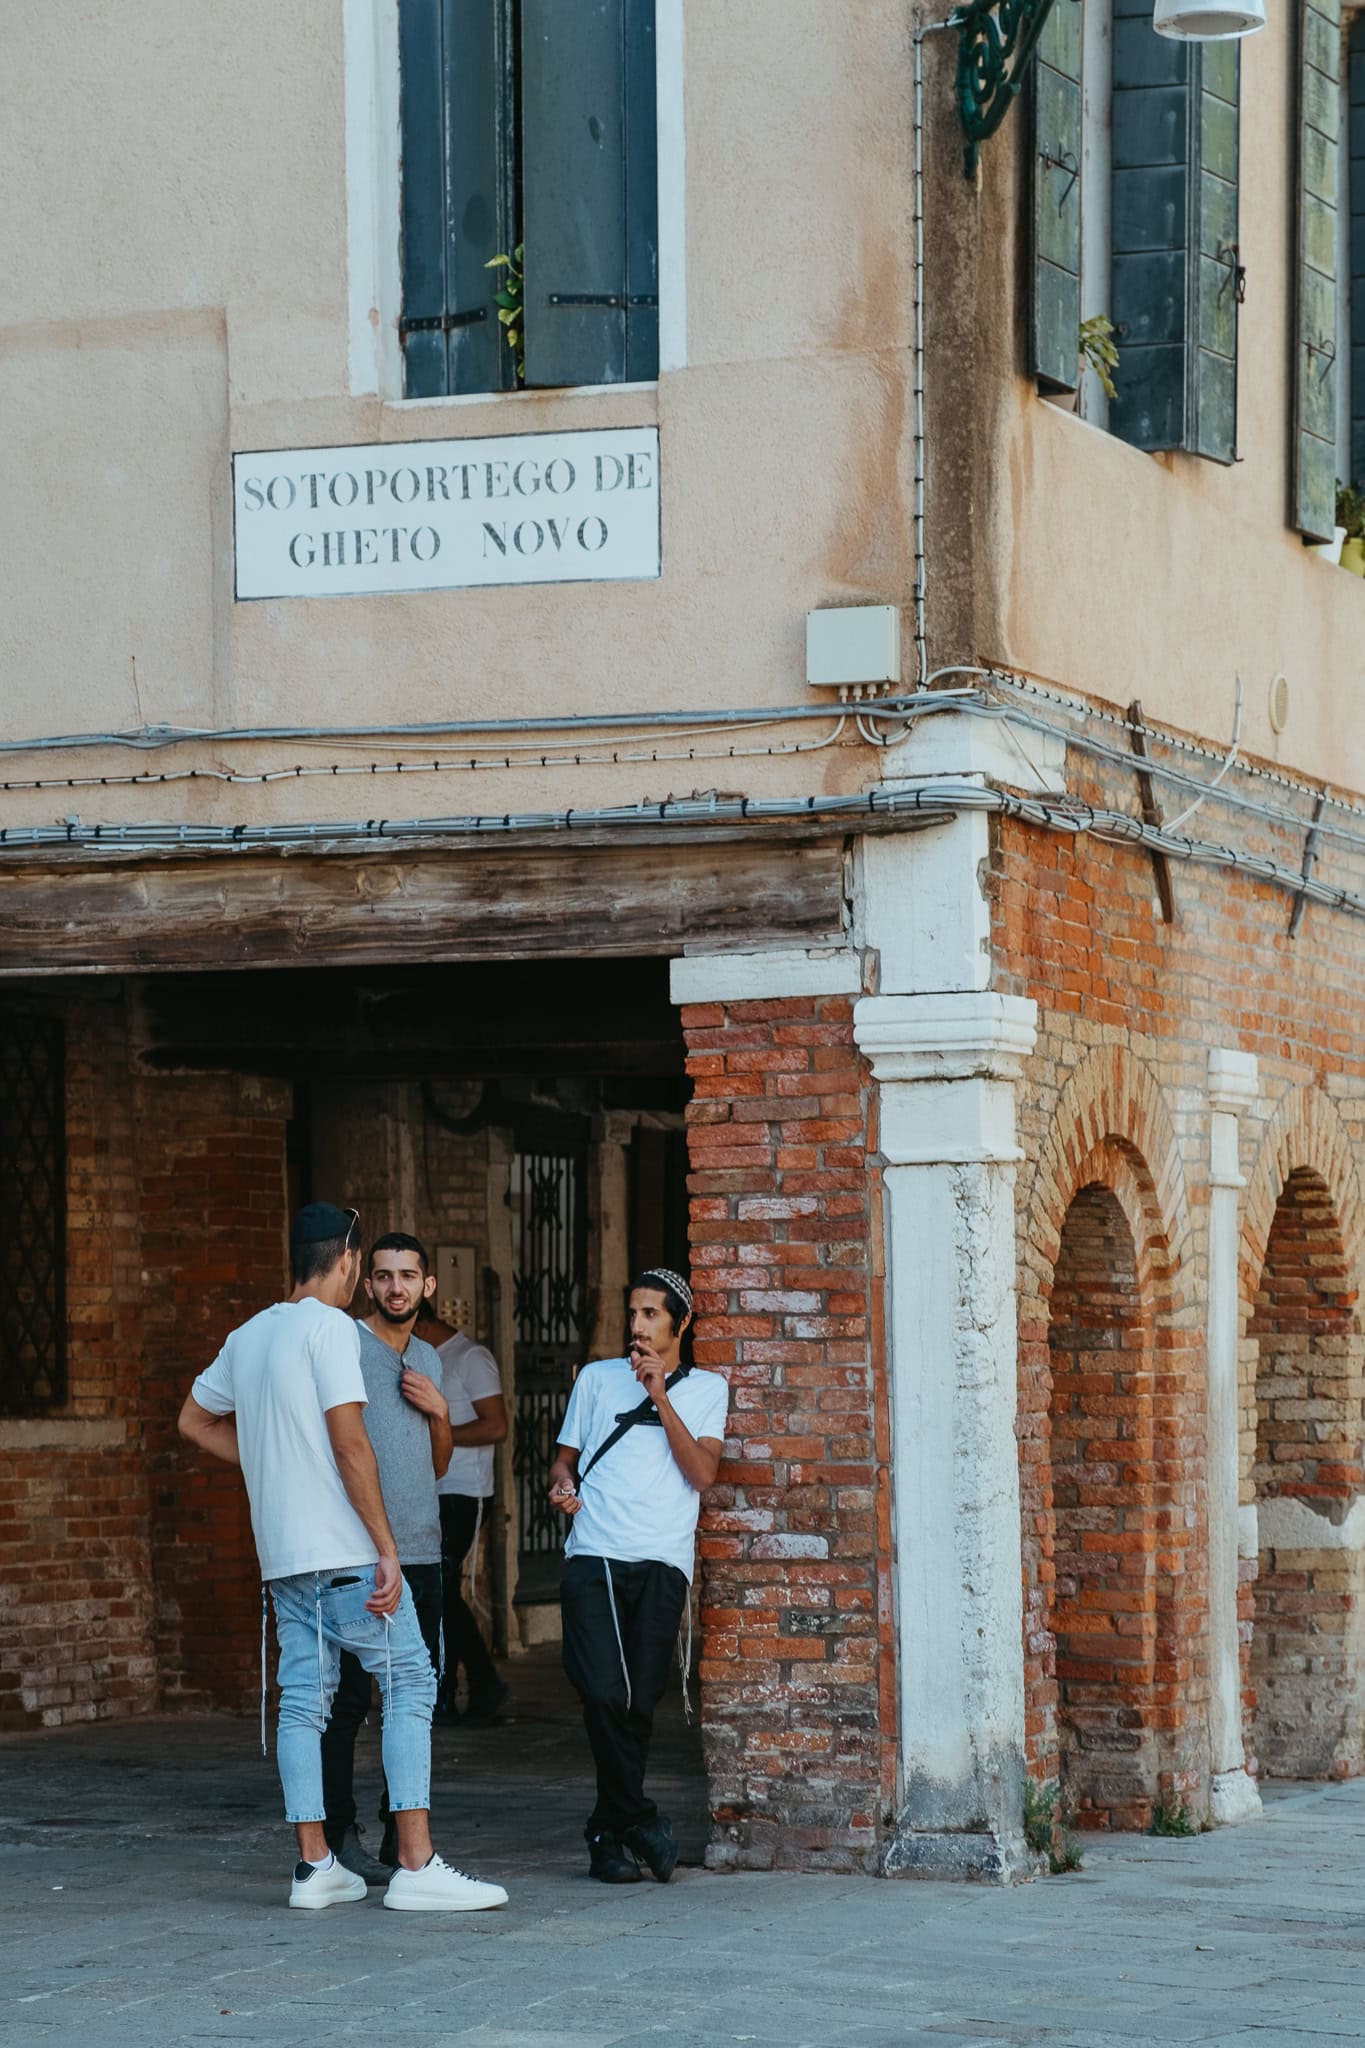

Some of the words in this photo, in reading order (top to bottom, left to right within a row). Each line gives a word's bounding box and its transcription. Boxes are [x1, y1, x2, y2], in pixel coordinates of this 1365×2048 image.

[243, 458, 576, 511] SOTOPORTEGO
[594, 452, 652, 493] DE
[289, 526, 441, 568] GHETO
[482, 516, 608, 558] NOVO
